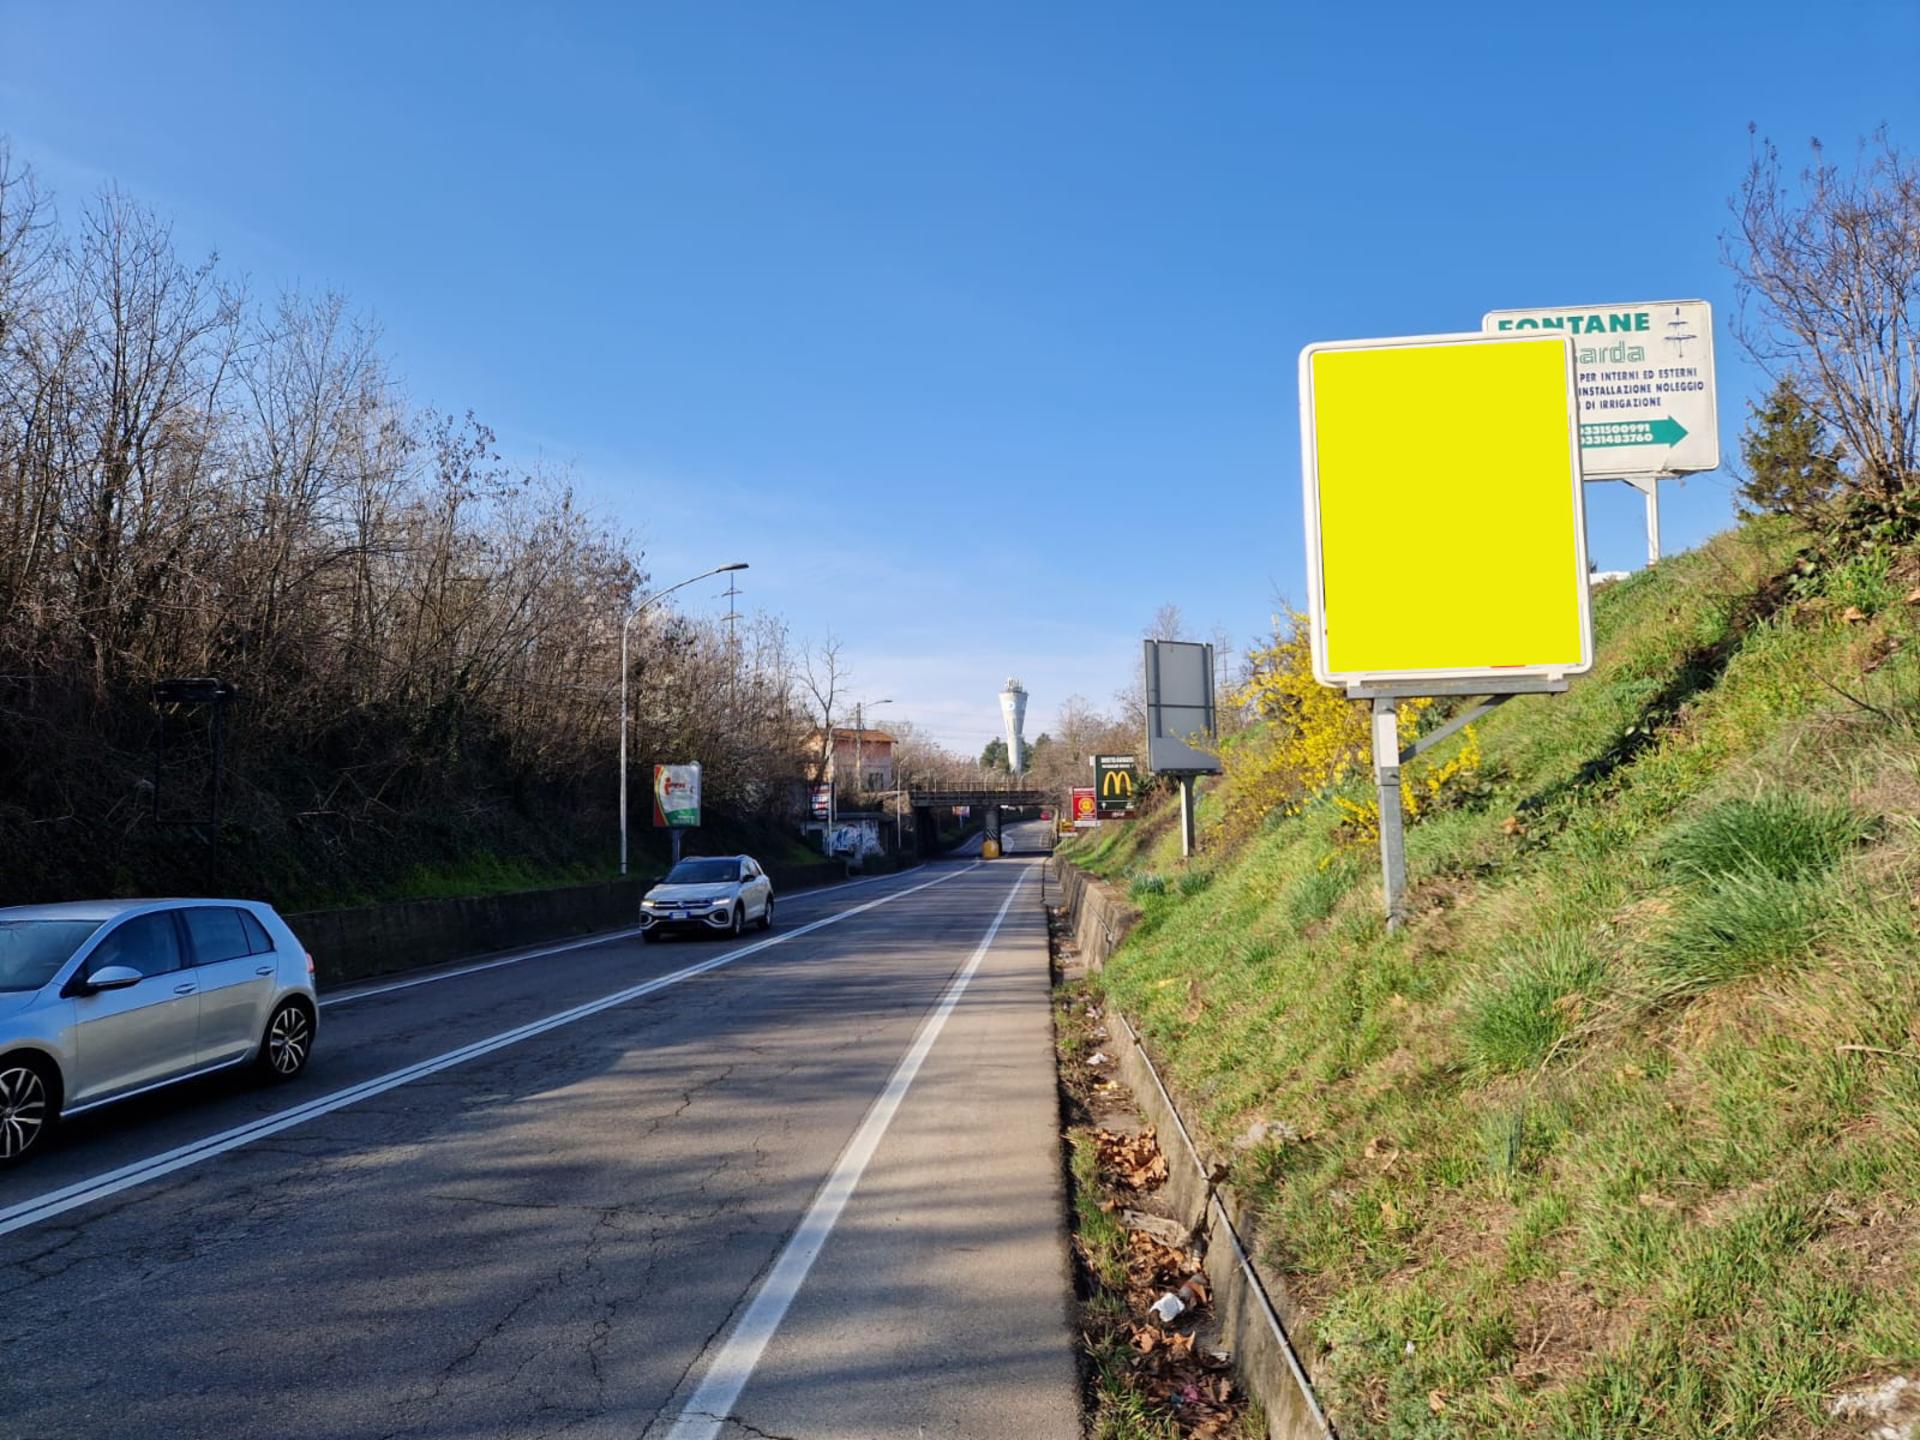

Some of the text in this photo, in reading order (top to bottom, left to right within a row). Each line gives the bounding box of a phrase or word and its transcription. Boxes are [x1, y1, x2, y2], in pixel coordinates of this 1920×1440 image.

[1498, 313, 1650, 334] FONTANE
[1574, 341, 1645, 364] arda
[1580, 368, 1697, 382] PER INTERNI ED ESTERNI
[1578, 381, 1704, 396] INSTALLAZIONE NOLEGGIO
[1585, 397, 1661, 410] DI IRRIGAZIONE
